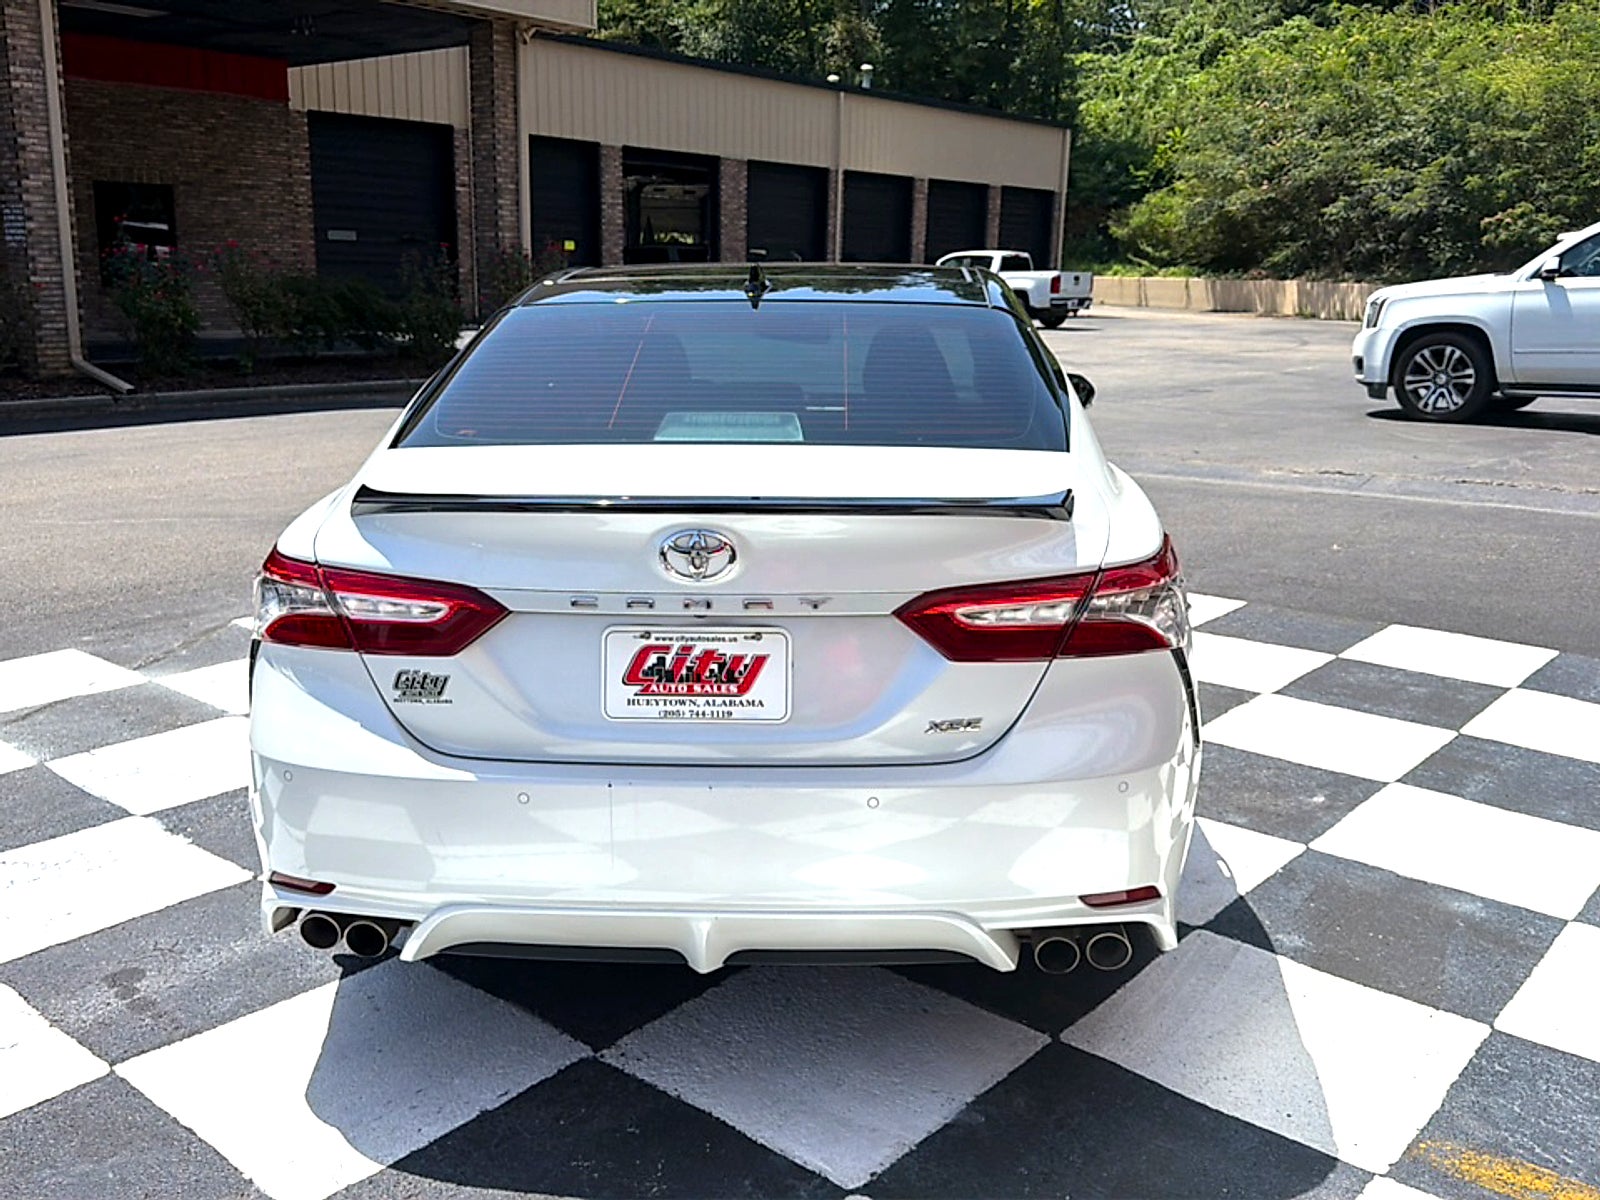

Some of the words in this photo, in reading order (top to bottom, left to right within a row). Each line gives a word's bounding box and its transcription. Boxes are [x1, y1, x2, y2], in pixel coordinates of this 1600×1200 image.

[570, 595, 833, 609] CAMRY
[654, 635, 739, 644] www.cityautosales.us
[622, 644, 770, 696] City
[392, 669, 451, 695] City
[649, 684, 688, 694] AUTO
[694, 684, 738, 694] SALES
[627, 698, 700, 708] HUEYTOWN,
[703, 699, 764, 708] ALABAMA
[658, 709, 686, 718] (205)
[689, 710, 733, 718] 744-1119
